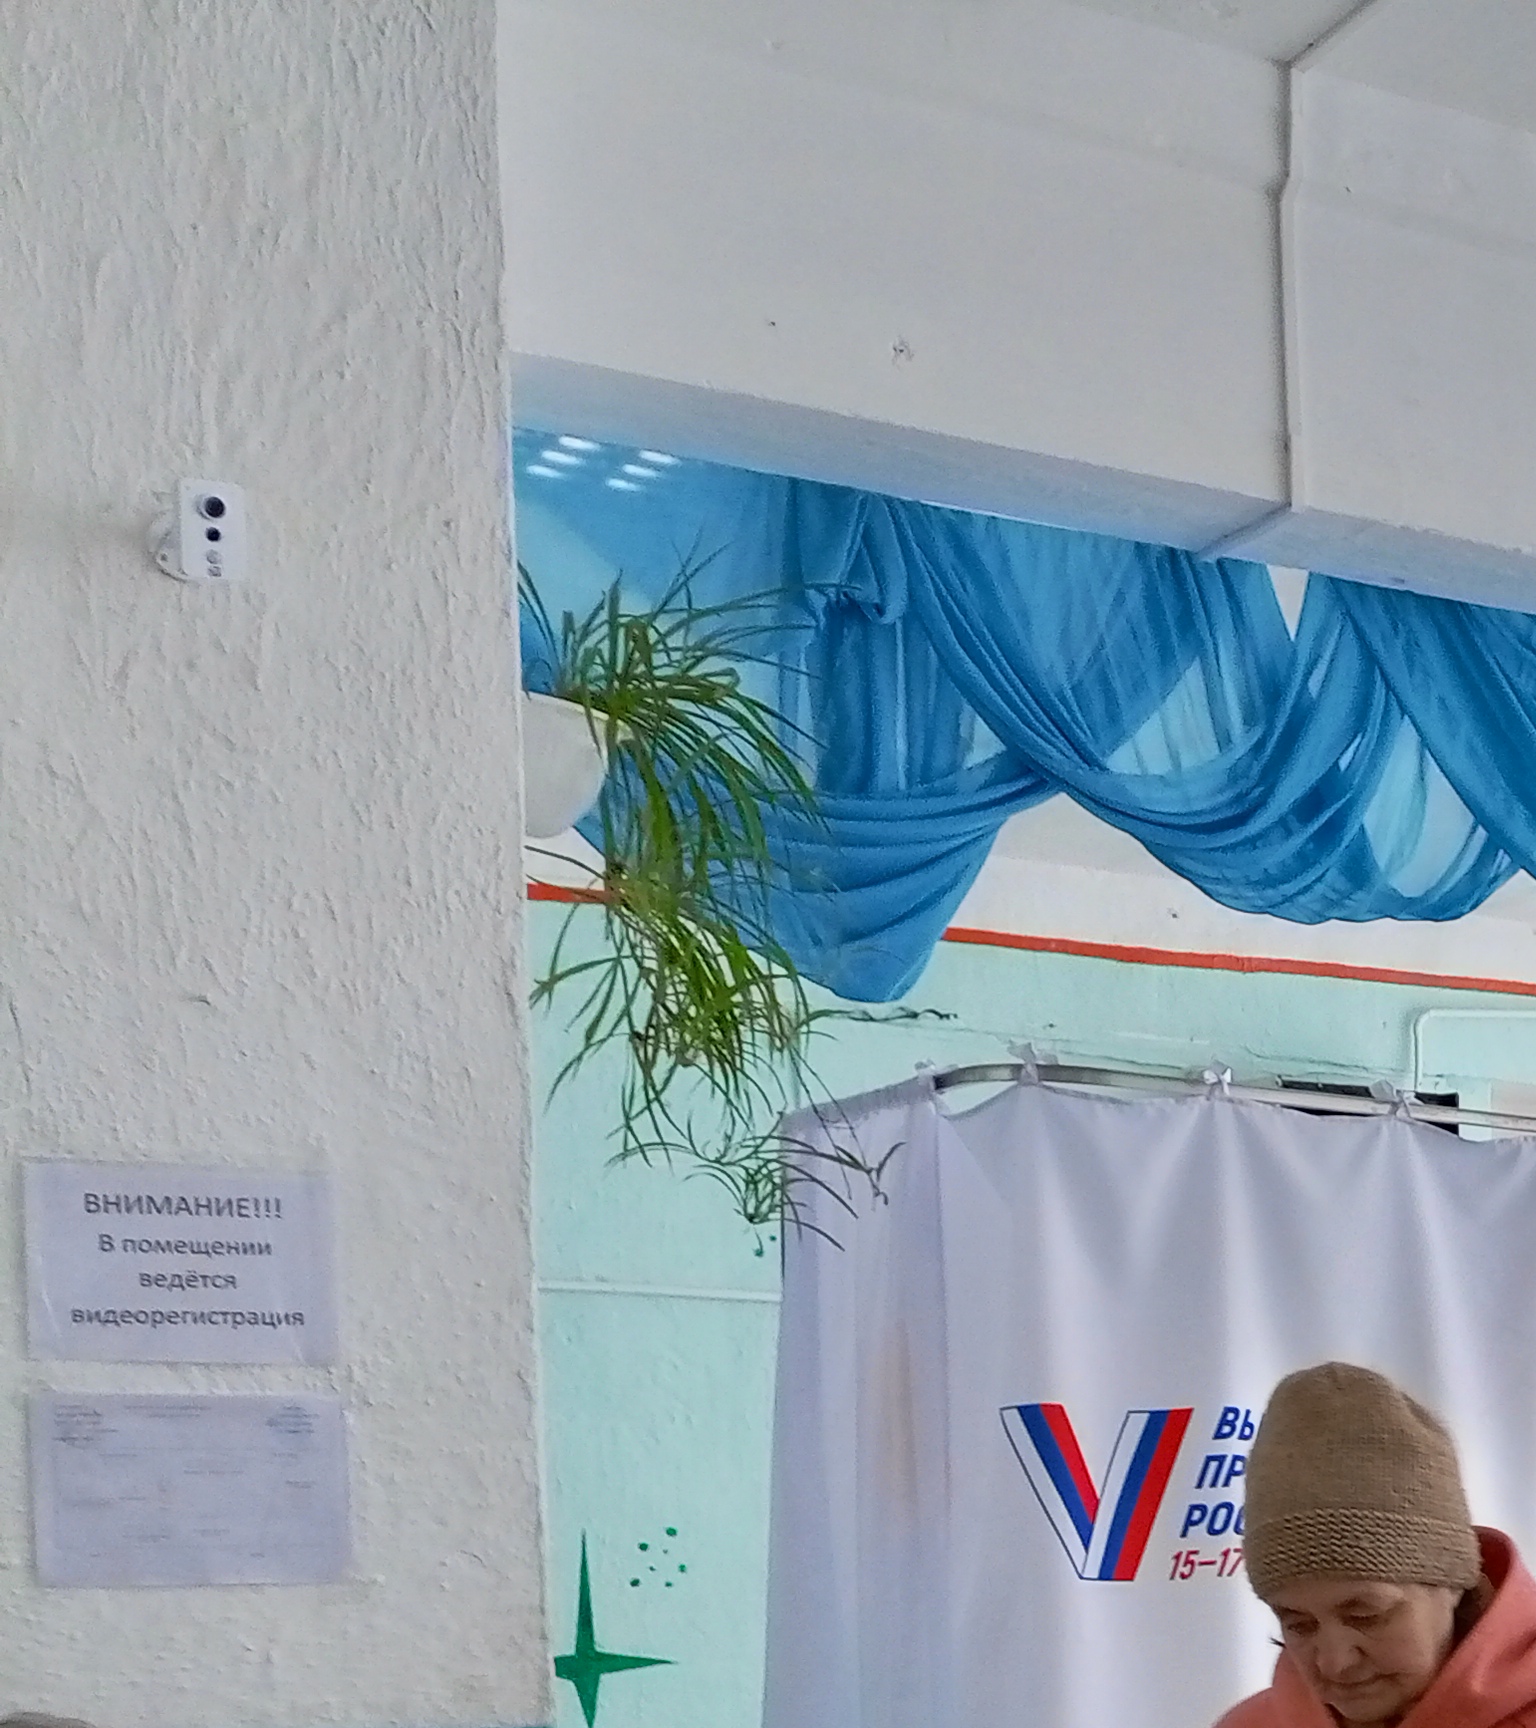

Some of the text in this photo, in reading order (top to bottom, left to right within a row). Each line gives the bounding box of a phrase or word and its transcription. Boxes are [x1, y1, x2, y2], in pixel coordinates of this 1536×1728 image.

[84, 1193, 282, 1219] ВНИМАНИЕ!!!
[98, 1233, 273, 1258] В помещении
[138, 1270, 237, 1292] ведётся
[70, 1308, 305, 1330] видеорегистрация
